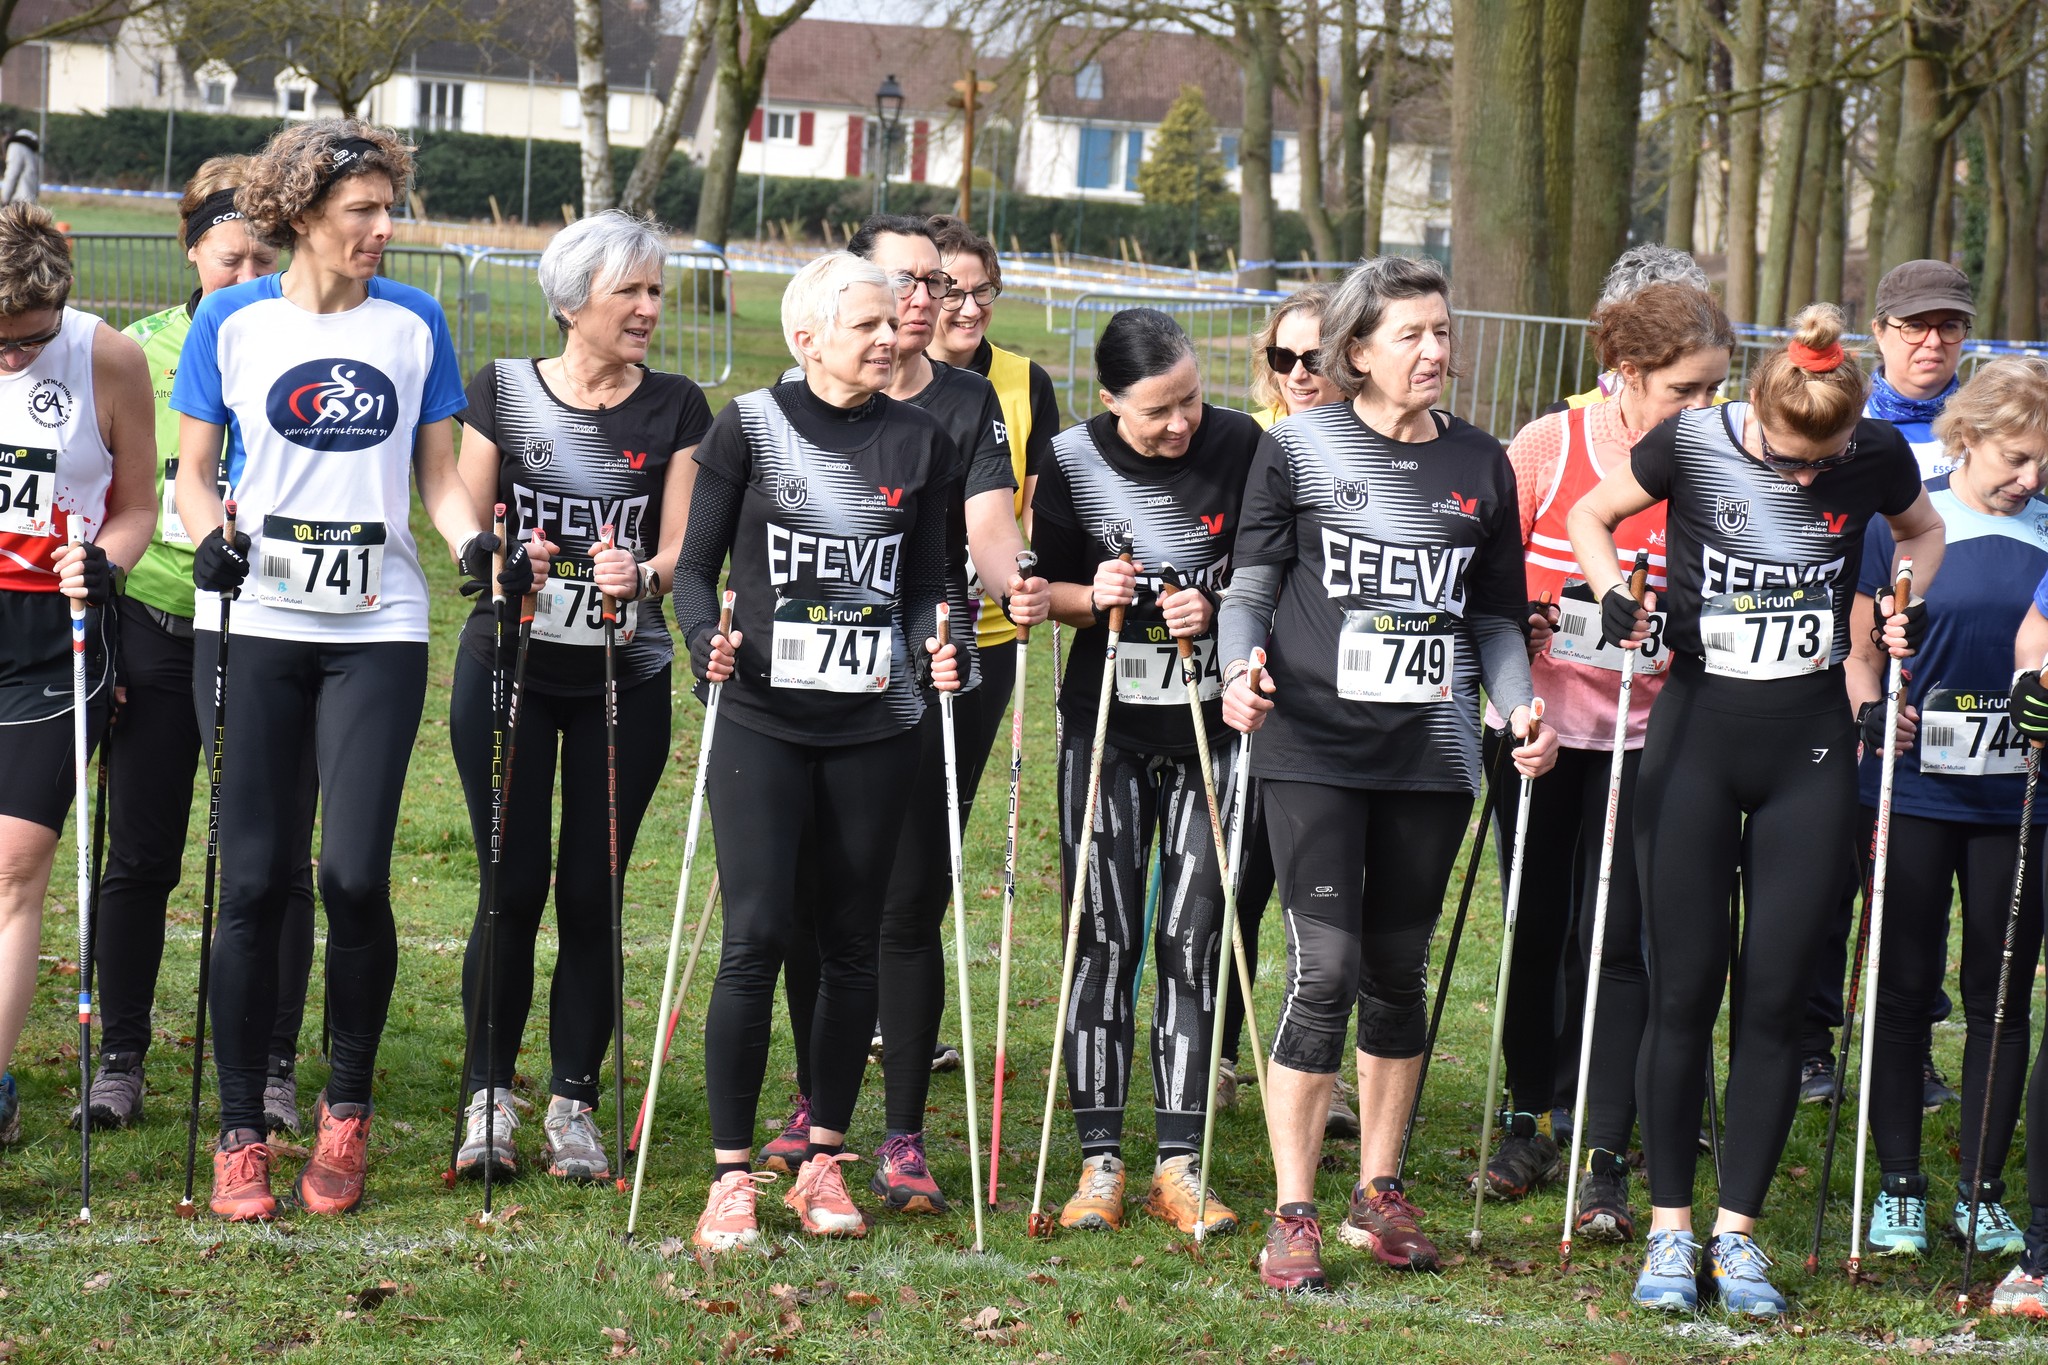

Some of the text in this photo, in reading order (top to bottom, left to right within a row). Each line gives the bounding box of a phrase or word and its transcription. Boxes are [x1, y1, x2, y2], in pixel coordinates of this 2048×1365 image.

[28, 378, 74, 405] CLUB ATHLÉTIQUE
[27, 406, 71, 429] AUBERGENVILLE
[350, 392, 385, 422] 91
[284, 425, 388, 436] SAVIGNY ATHLÉTISME 91
[1335, 480, 1367, 493] EFCVO
[513, 482, 649, 549] EFCVO
[1431, 501, 1460, 511] d'oise
[1446, 498, 1460, 506] val
[1718, 499, 1748, 515] EFCVO
[316, 525, 351, 541] i-run
[1104, 522, 1132, 534] EFCVO
[1184, 530, 1209, 538] d'oise
[222, 544, 243, 563] LEKI
[511, 546, 525, 565] LEKI
[766, 521, 904, 596] EFCVO
[302, 547, 370, 595] 741
[1321, 526, 1476, 619] EFCVO
[1701, 543, 1846, 607] EFCVO
[829, 605, 863, 622] i-run
[1757, 594, 1794, 609] i-run
[1397, 616, 1429, 632] i-run
[1745, 614, 1820, 663] 773
[816, 628, 881, 675] 747
[1157, 642, 1222, 689] 764
[1382, 638, 1446, 685] 749
[1552, 647, 1592, 661] Crédit Mutuel
[1966, 716, 2033, 758] 744
[491, 730, 502, 863] PACEMAKER
[1005, 769, 1017, 884] EXCLUSIVE
[1206, 794, 1221, 848] GUIDETTI
[1606, 788, 1618, 847] GUIDETTI
[1879, 799, 1889, 858] GUIDETTI
[2013, 859, 2026, 916] GUIDETTI
